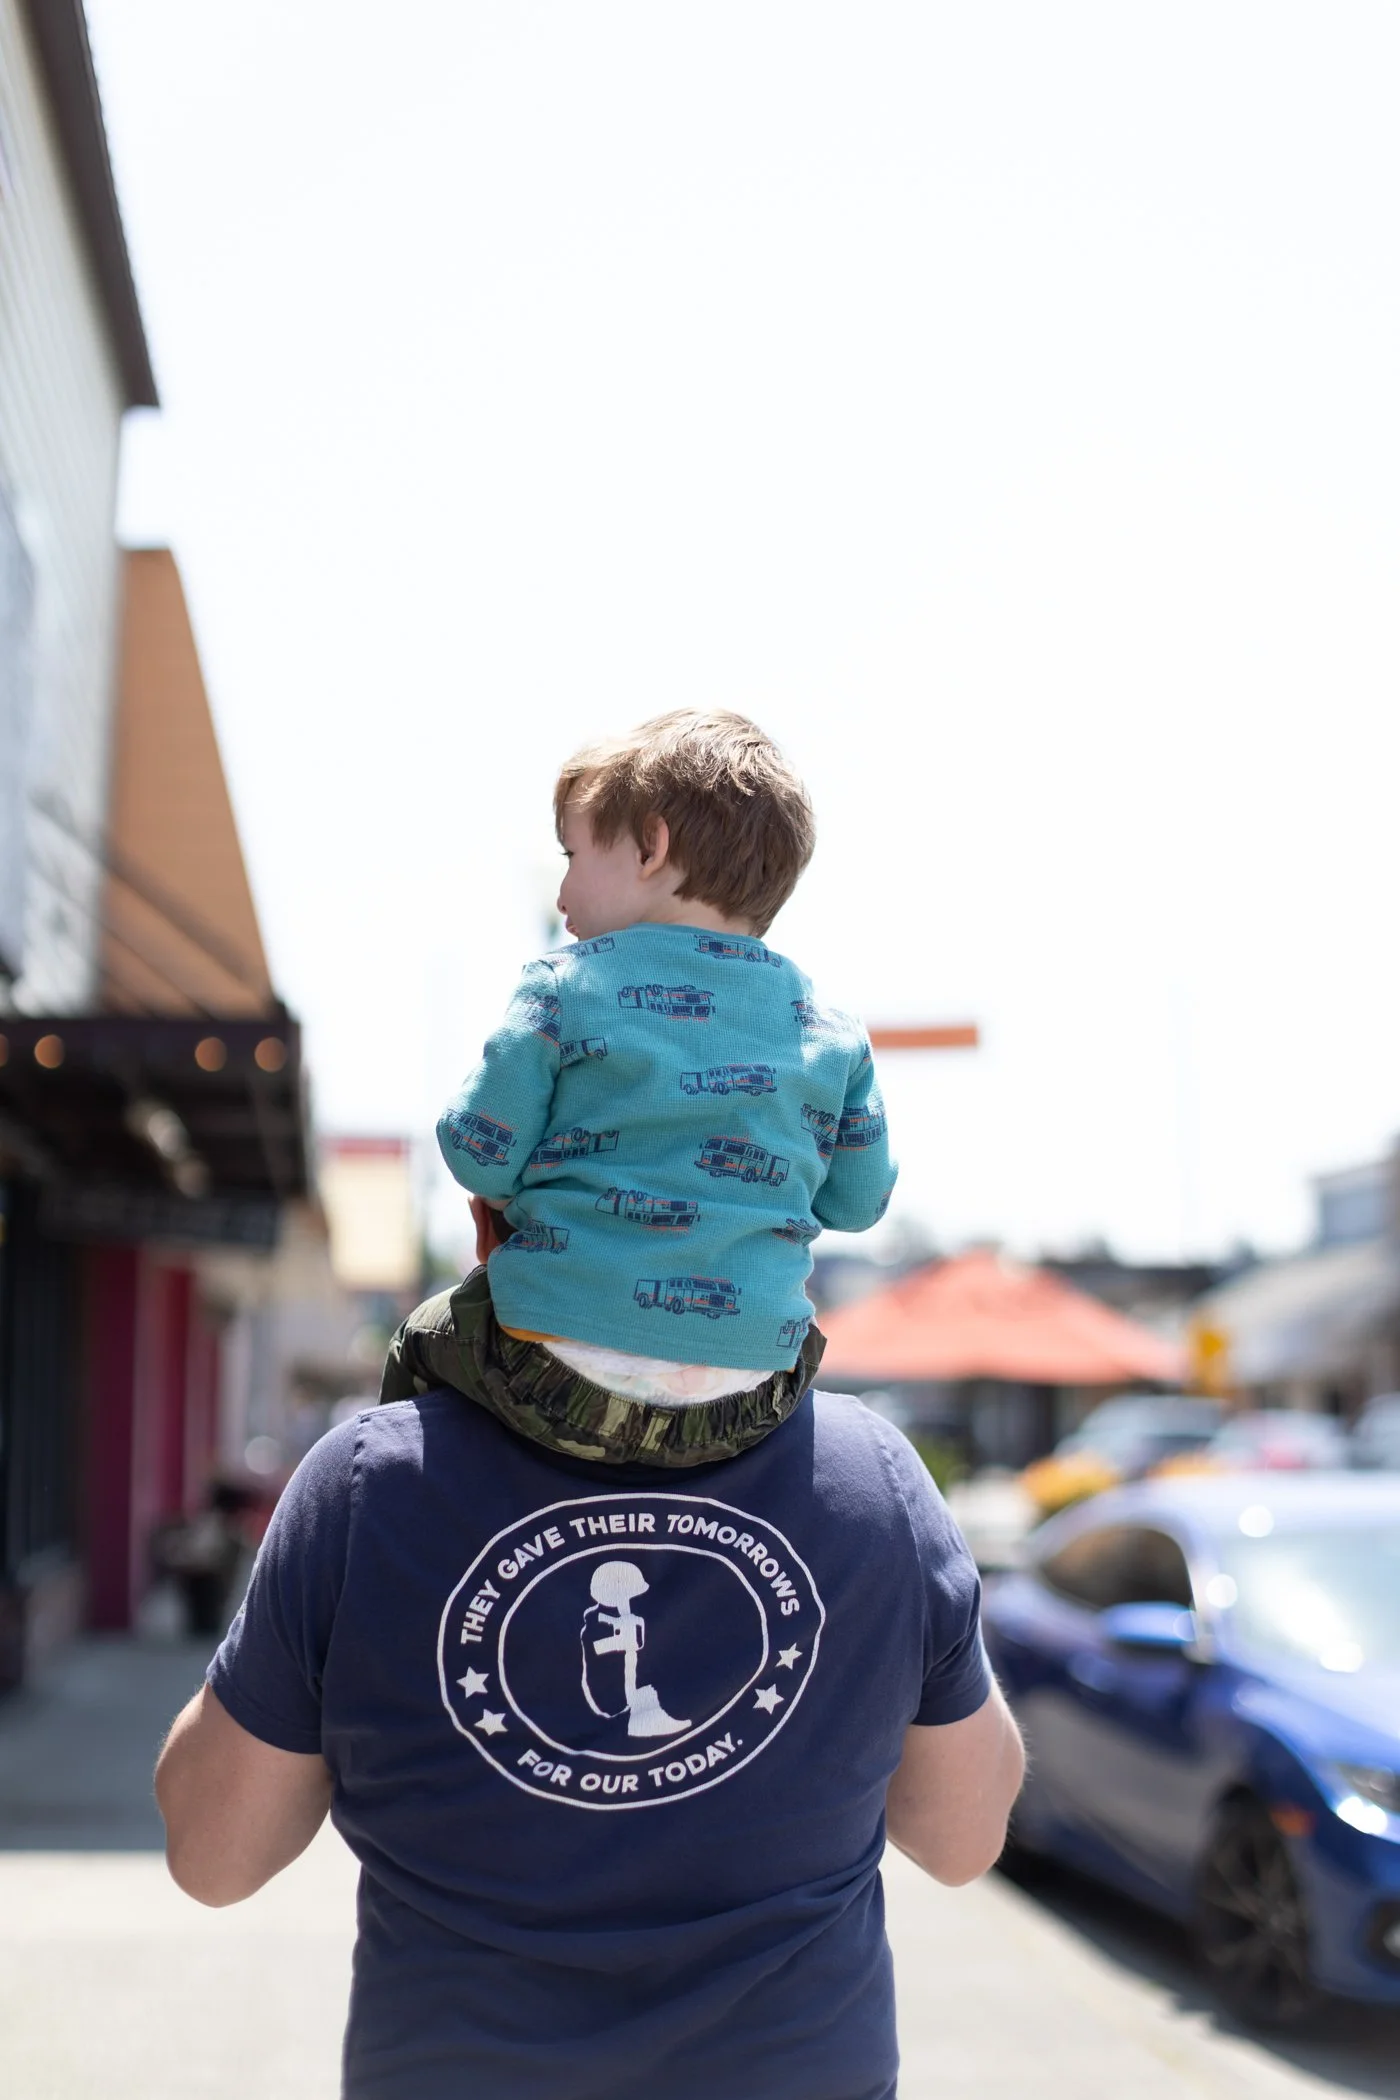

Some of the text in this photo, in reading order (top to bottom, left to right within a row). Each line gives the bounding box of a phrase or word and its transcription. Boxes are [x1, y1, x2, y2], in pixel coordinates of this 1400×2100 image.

[460, 1513, 800, 1644] THEY GAVE THEIR TOMORROWS
[517, 1732, 744, 1794] FOR OUR TODAY.
